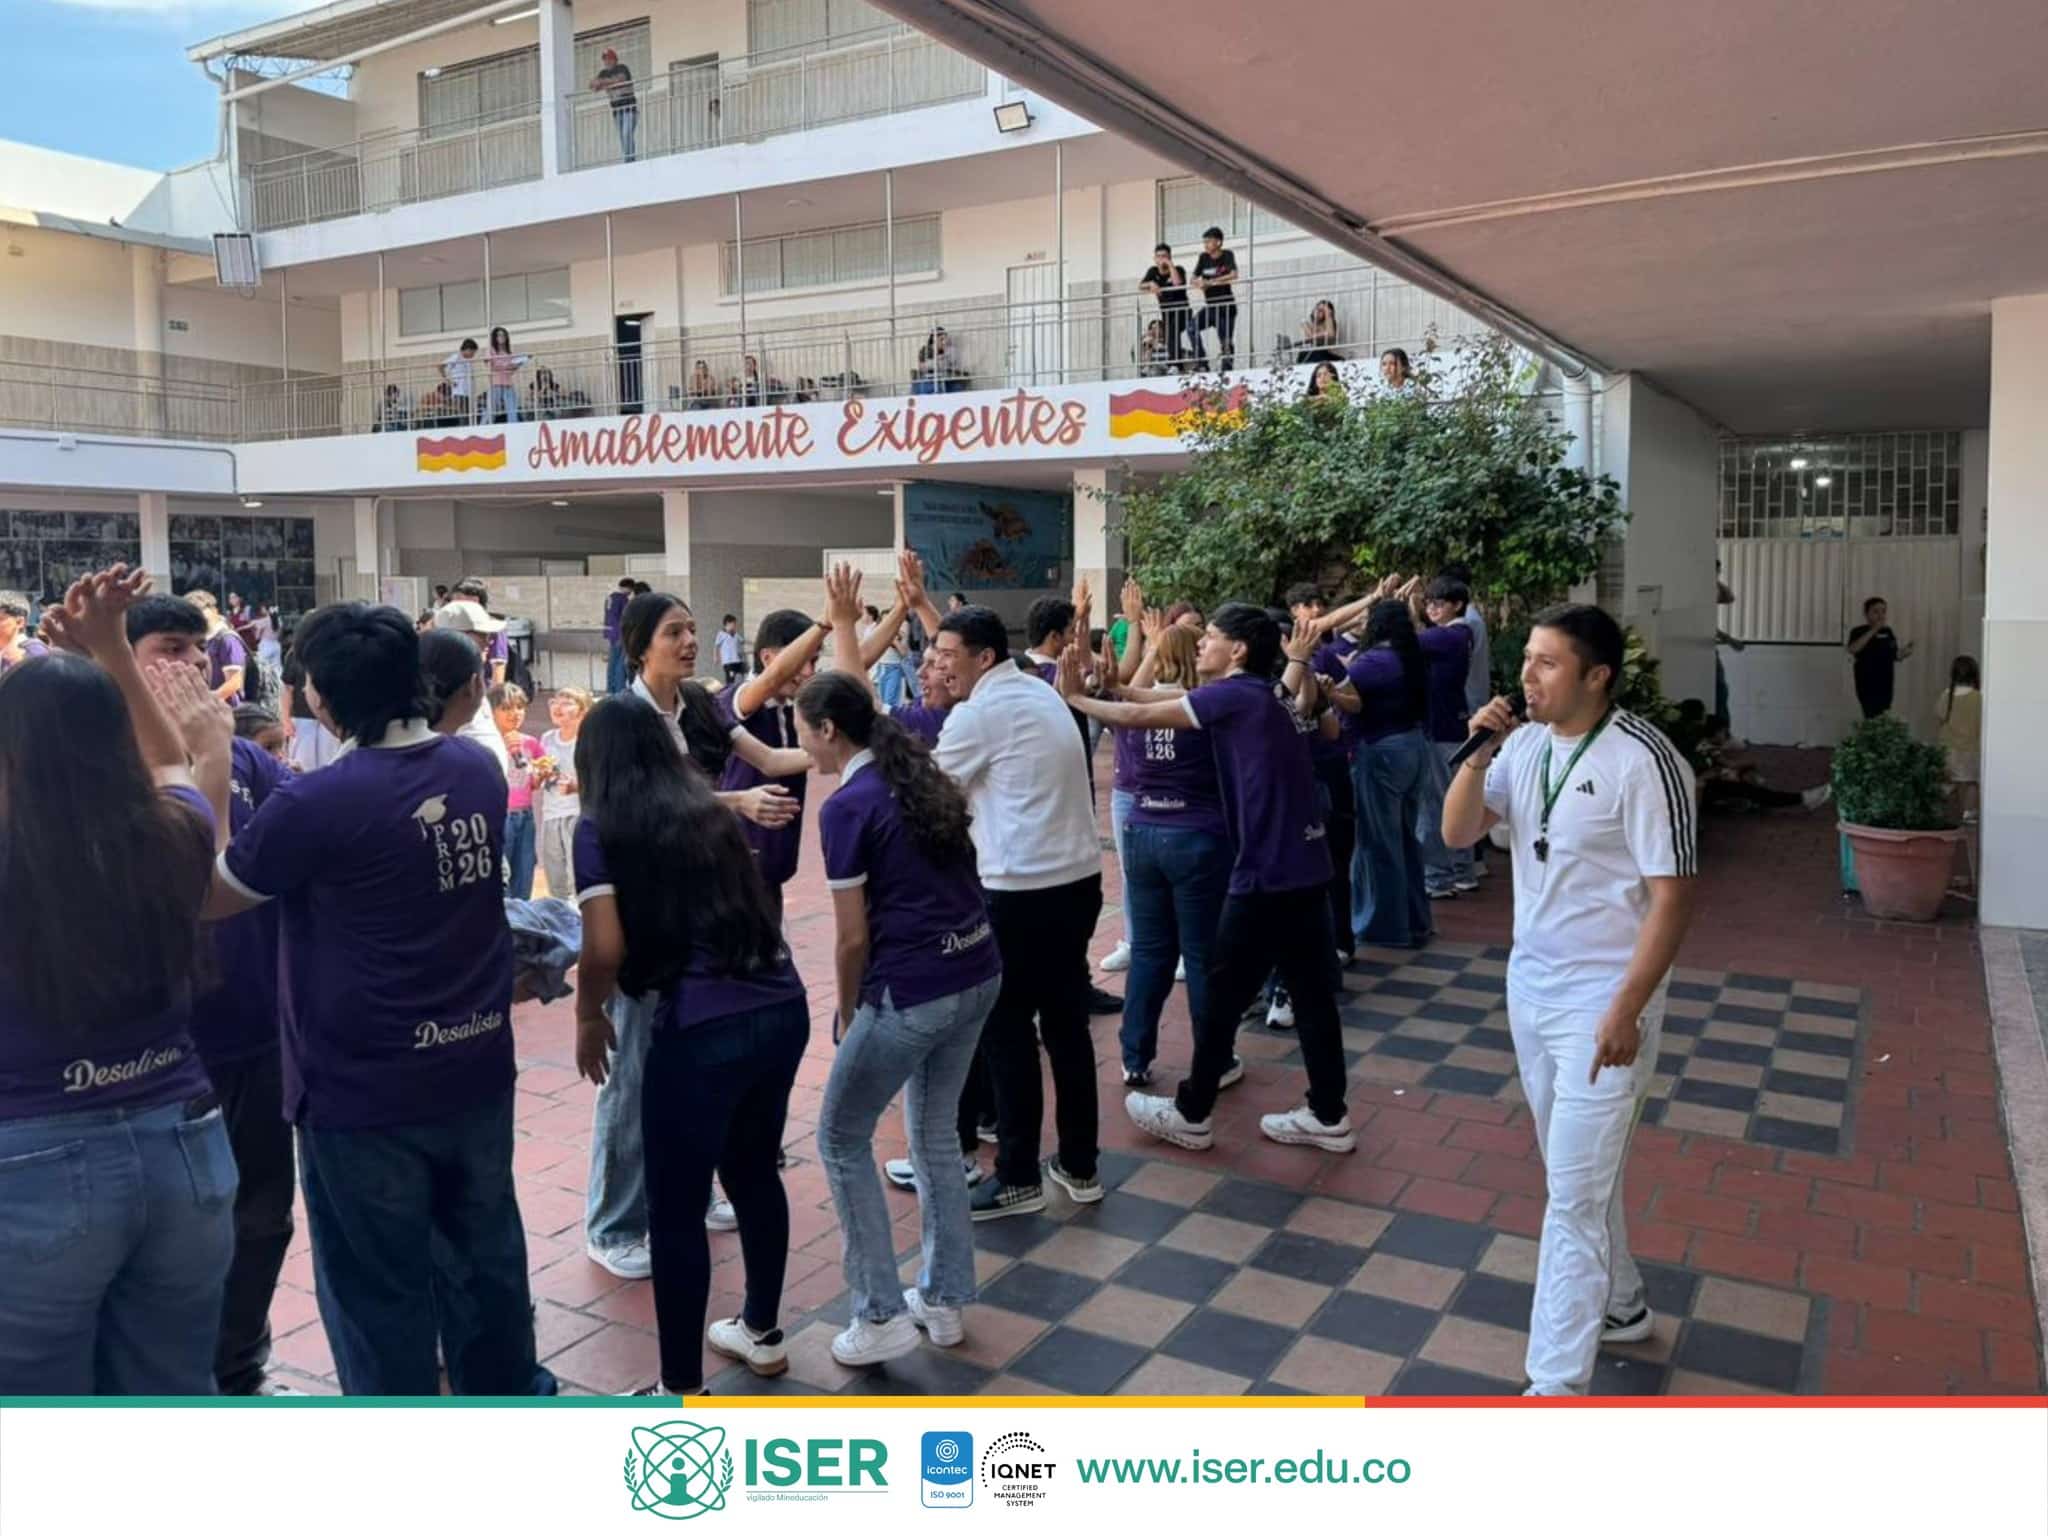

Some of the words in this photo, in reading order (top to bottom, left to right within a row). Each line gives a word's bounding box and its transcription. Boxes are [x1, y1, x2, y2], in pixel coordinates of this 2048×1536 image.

[528, 405, 815, 469] Amablemente
[837, 387, 1087, 464] Exigentes
[1155, 743, 1176, 760] 26
[450, 812, 487, 851] 20
[458, 845, 492, 887] 26
